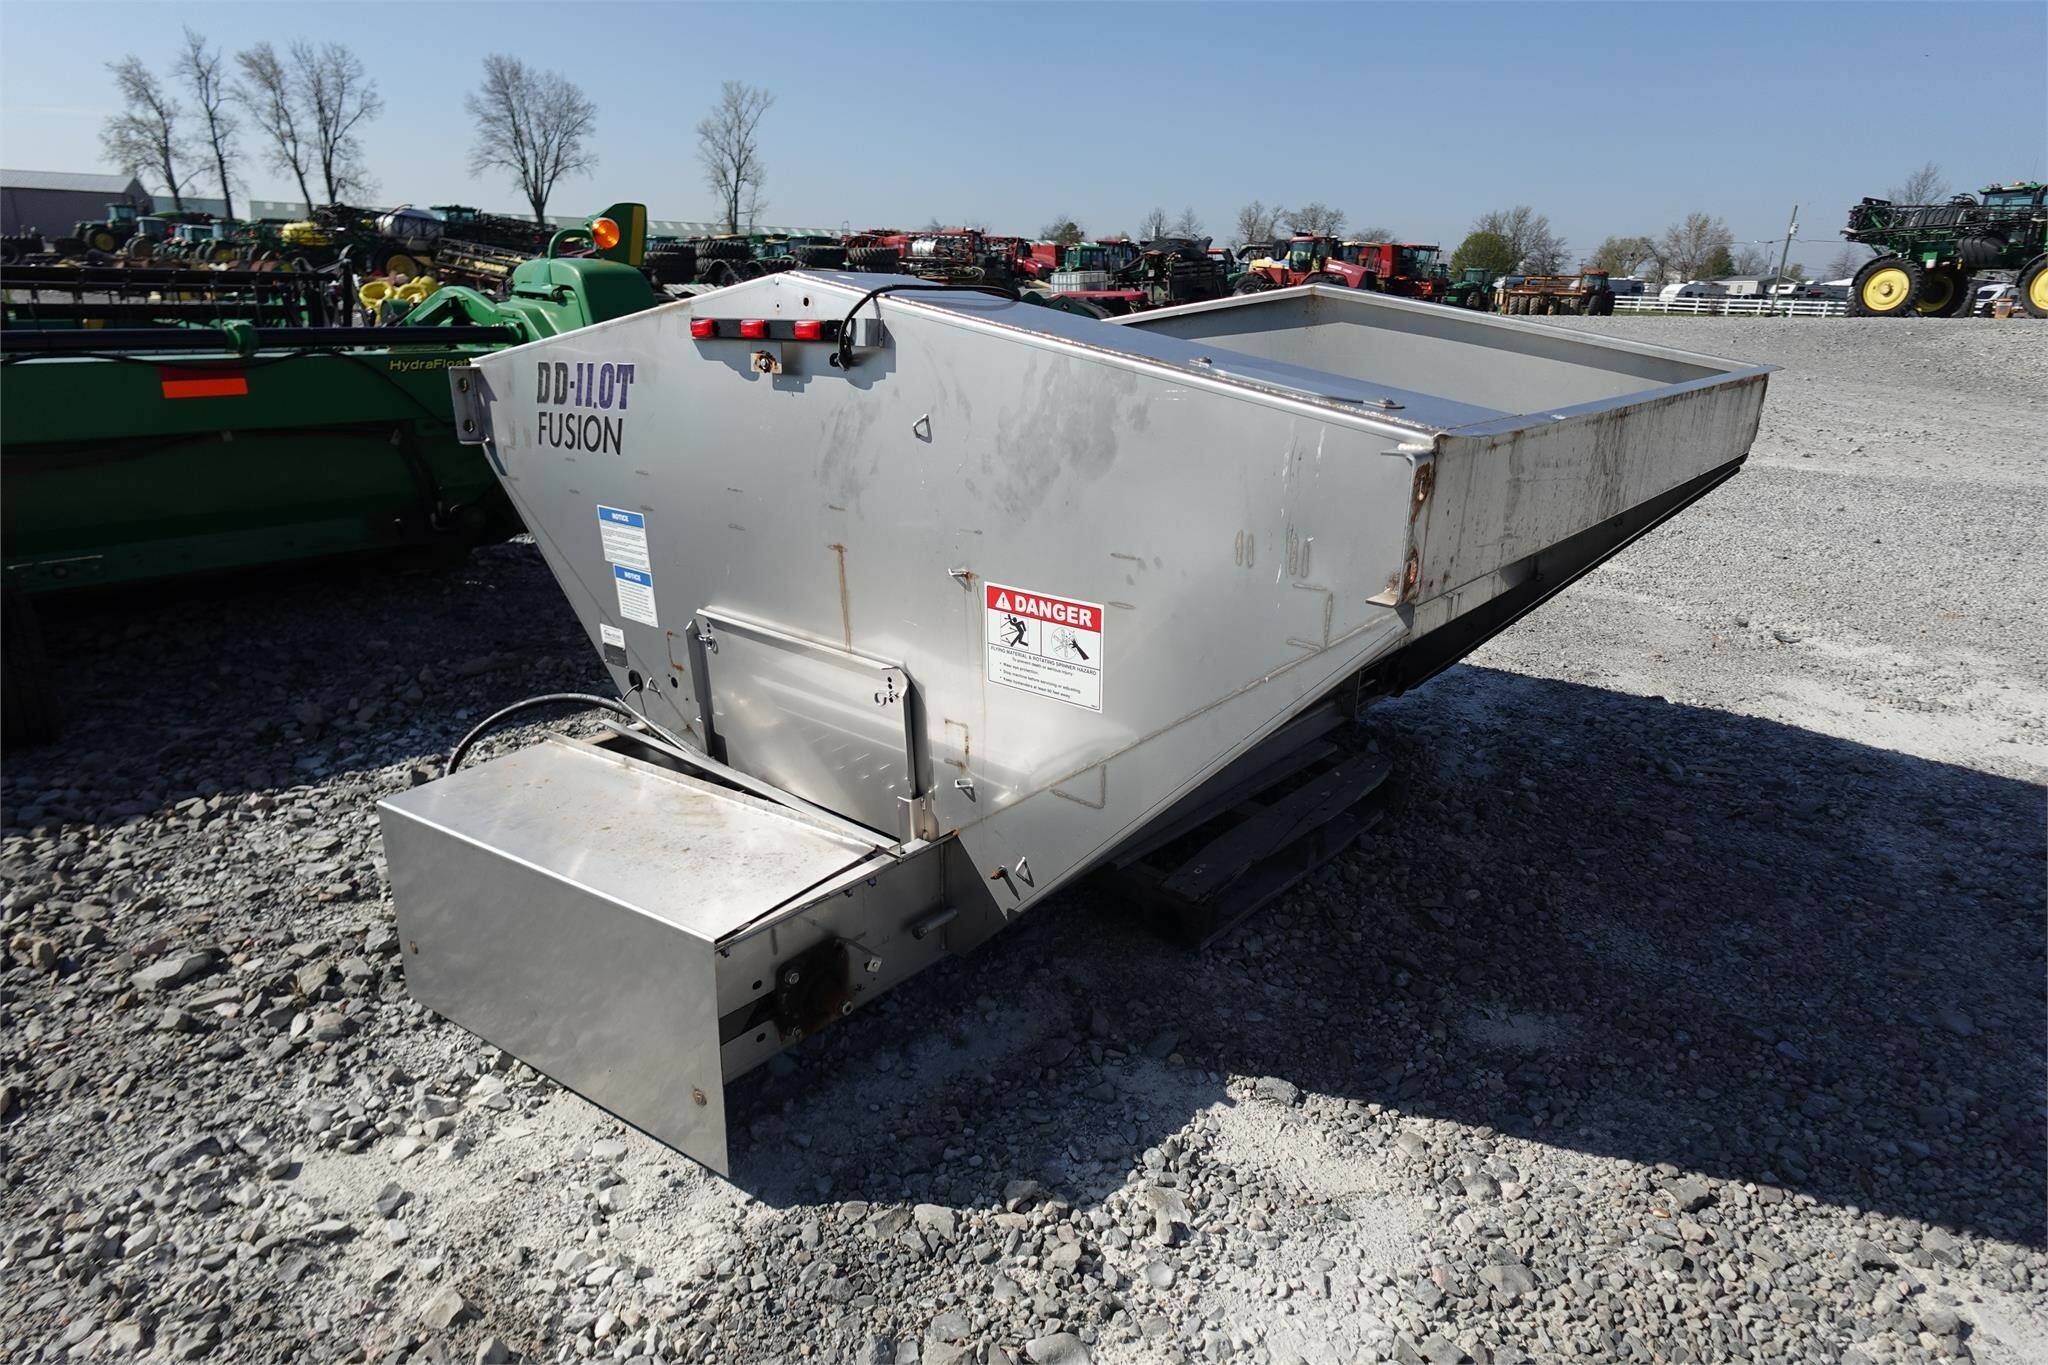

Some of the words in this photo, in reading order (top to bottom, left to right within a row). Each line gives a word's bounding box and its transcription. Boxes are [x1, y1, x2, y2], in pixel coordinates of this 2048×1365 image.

[389, 358, 469, 372] HydraFloat
[538, 411, 623, 455] FUSION
[611, 512, 629, 522] NOTICE
[623, 570, 642, 581] NOTICE
[1014, 594, 1093, 627] DANGER
[990, 646, 1006, 654] FLYING
[1006, 650, 1028, 659] MATERIAL
[1033, 656, 1055, 666] ROTATING
[1056, 662, 1076, 670] SPINNER
[1076, 667, 1097, 676] HAZARD
